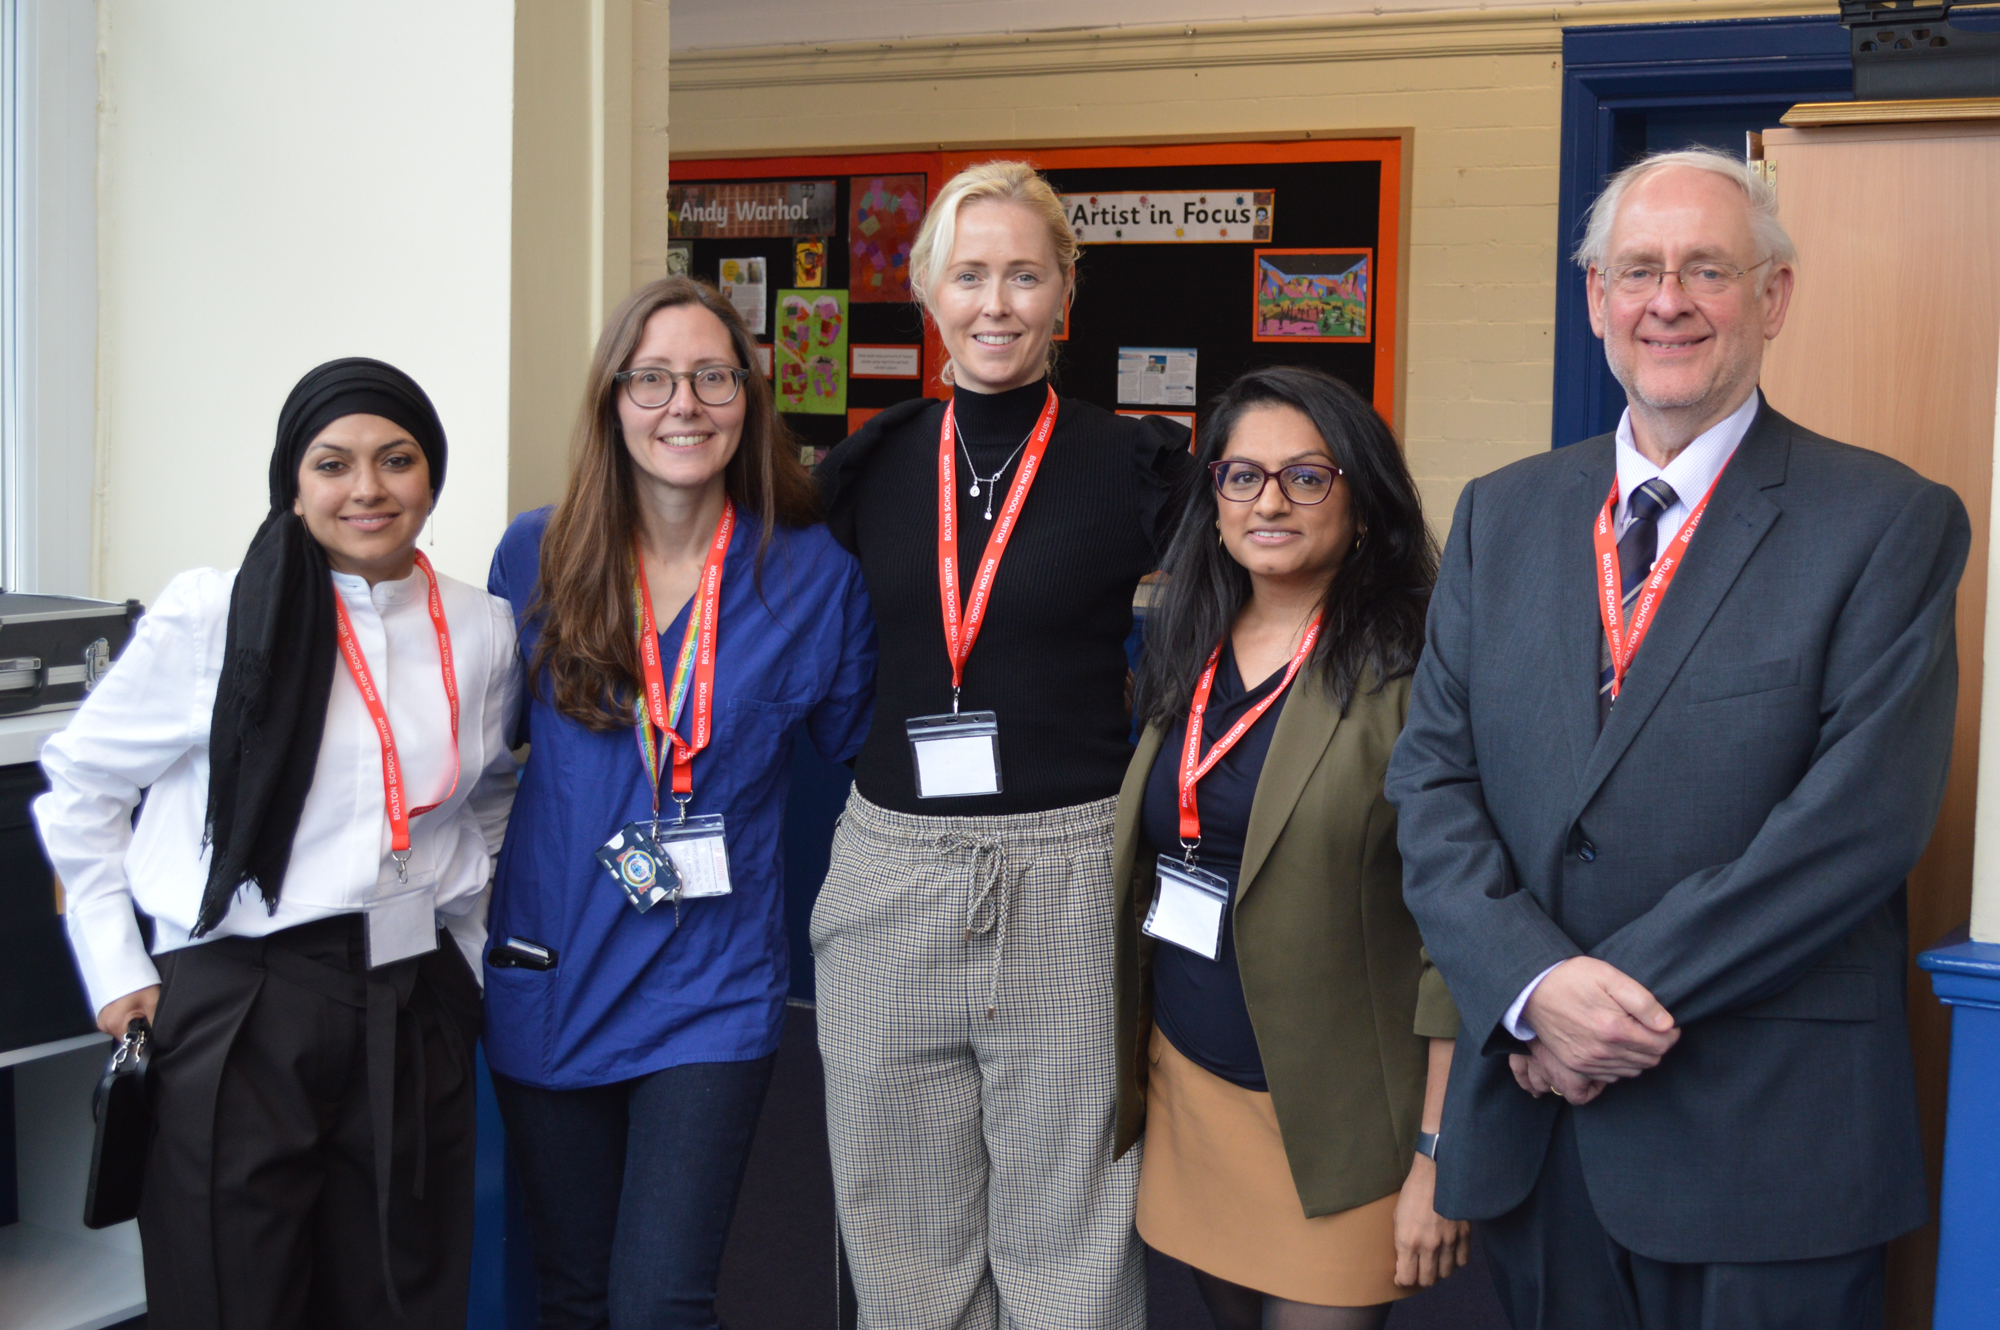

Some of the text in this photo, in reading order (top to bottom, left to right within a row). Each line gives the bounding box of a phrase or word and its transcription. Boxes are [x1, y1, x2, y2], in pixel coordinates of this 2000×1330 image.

[679, 197, 809, 228] Andy Warhol
[1071, 202, 1251, 226] Artist in Focus
[1037, 417, 1052, 442] VISITOR
[995, 455, 1037, 544] BOLTON SCHOOL VISITOR
[716, 518, 731, 549] BOLTON
[944, 513, 952, 541] BOLTON
[944, 557, 953, 588] VISITOR
[1602, 553, 1613, 587] BOLTON
[431, 588, 440, 618] VISITOR
[701, 564, 718, 665] BOLTON SCHOOL VISITOR
[947, 589, 957, 623] SCHOOL
[960, 559, 995, 657] BOLTON SCHOOL VISITOR
[1606, 589, 1617, 626] SCHOOL
[1622, 557, 1675, 667] BOLTON SCHOOL VISITOR
[345, 637, 362, 670] SCHOOL
[440, 633, 450, 665] BOLTON
[445, 667, 455, 698] SCHOOL
[645, 634, 655, 666] VISITOR
[1256, 625, 1321, 711] BOLTON SCHOOL VISITOR
[358, 671, 376, 701] BOLTON
[651, 683, 662, 715] BOLTON
[697, 682, 708, 748] SCHOOL VISITOR
[1192, 704, 1203, 735] BOLTON
[1186, 737, 1197, 769] SCHOOL
[1195, 749, 1221, 776] SCHOOL
[1219, 722, 1246, 749] VISITOR
[378, 717, 401, 820] BOLTON SCHOOL VISITOR
